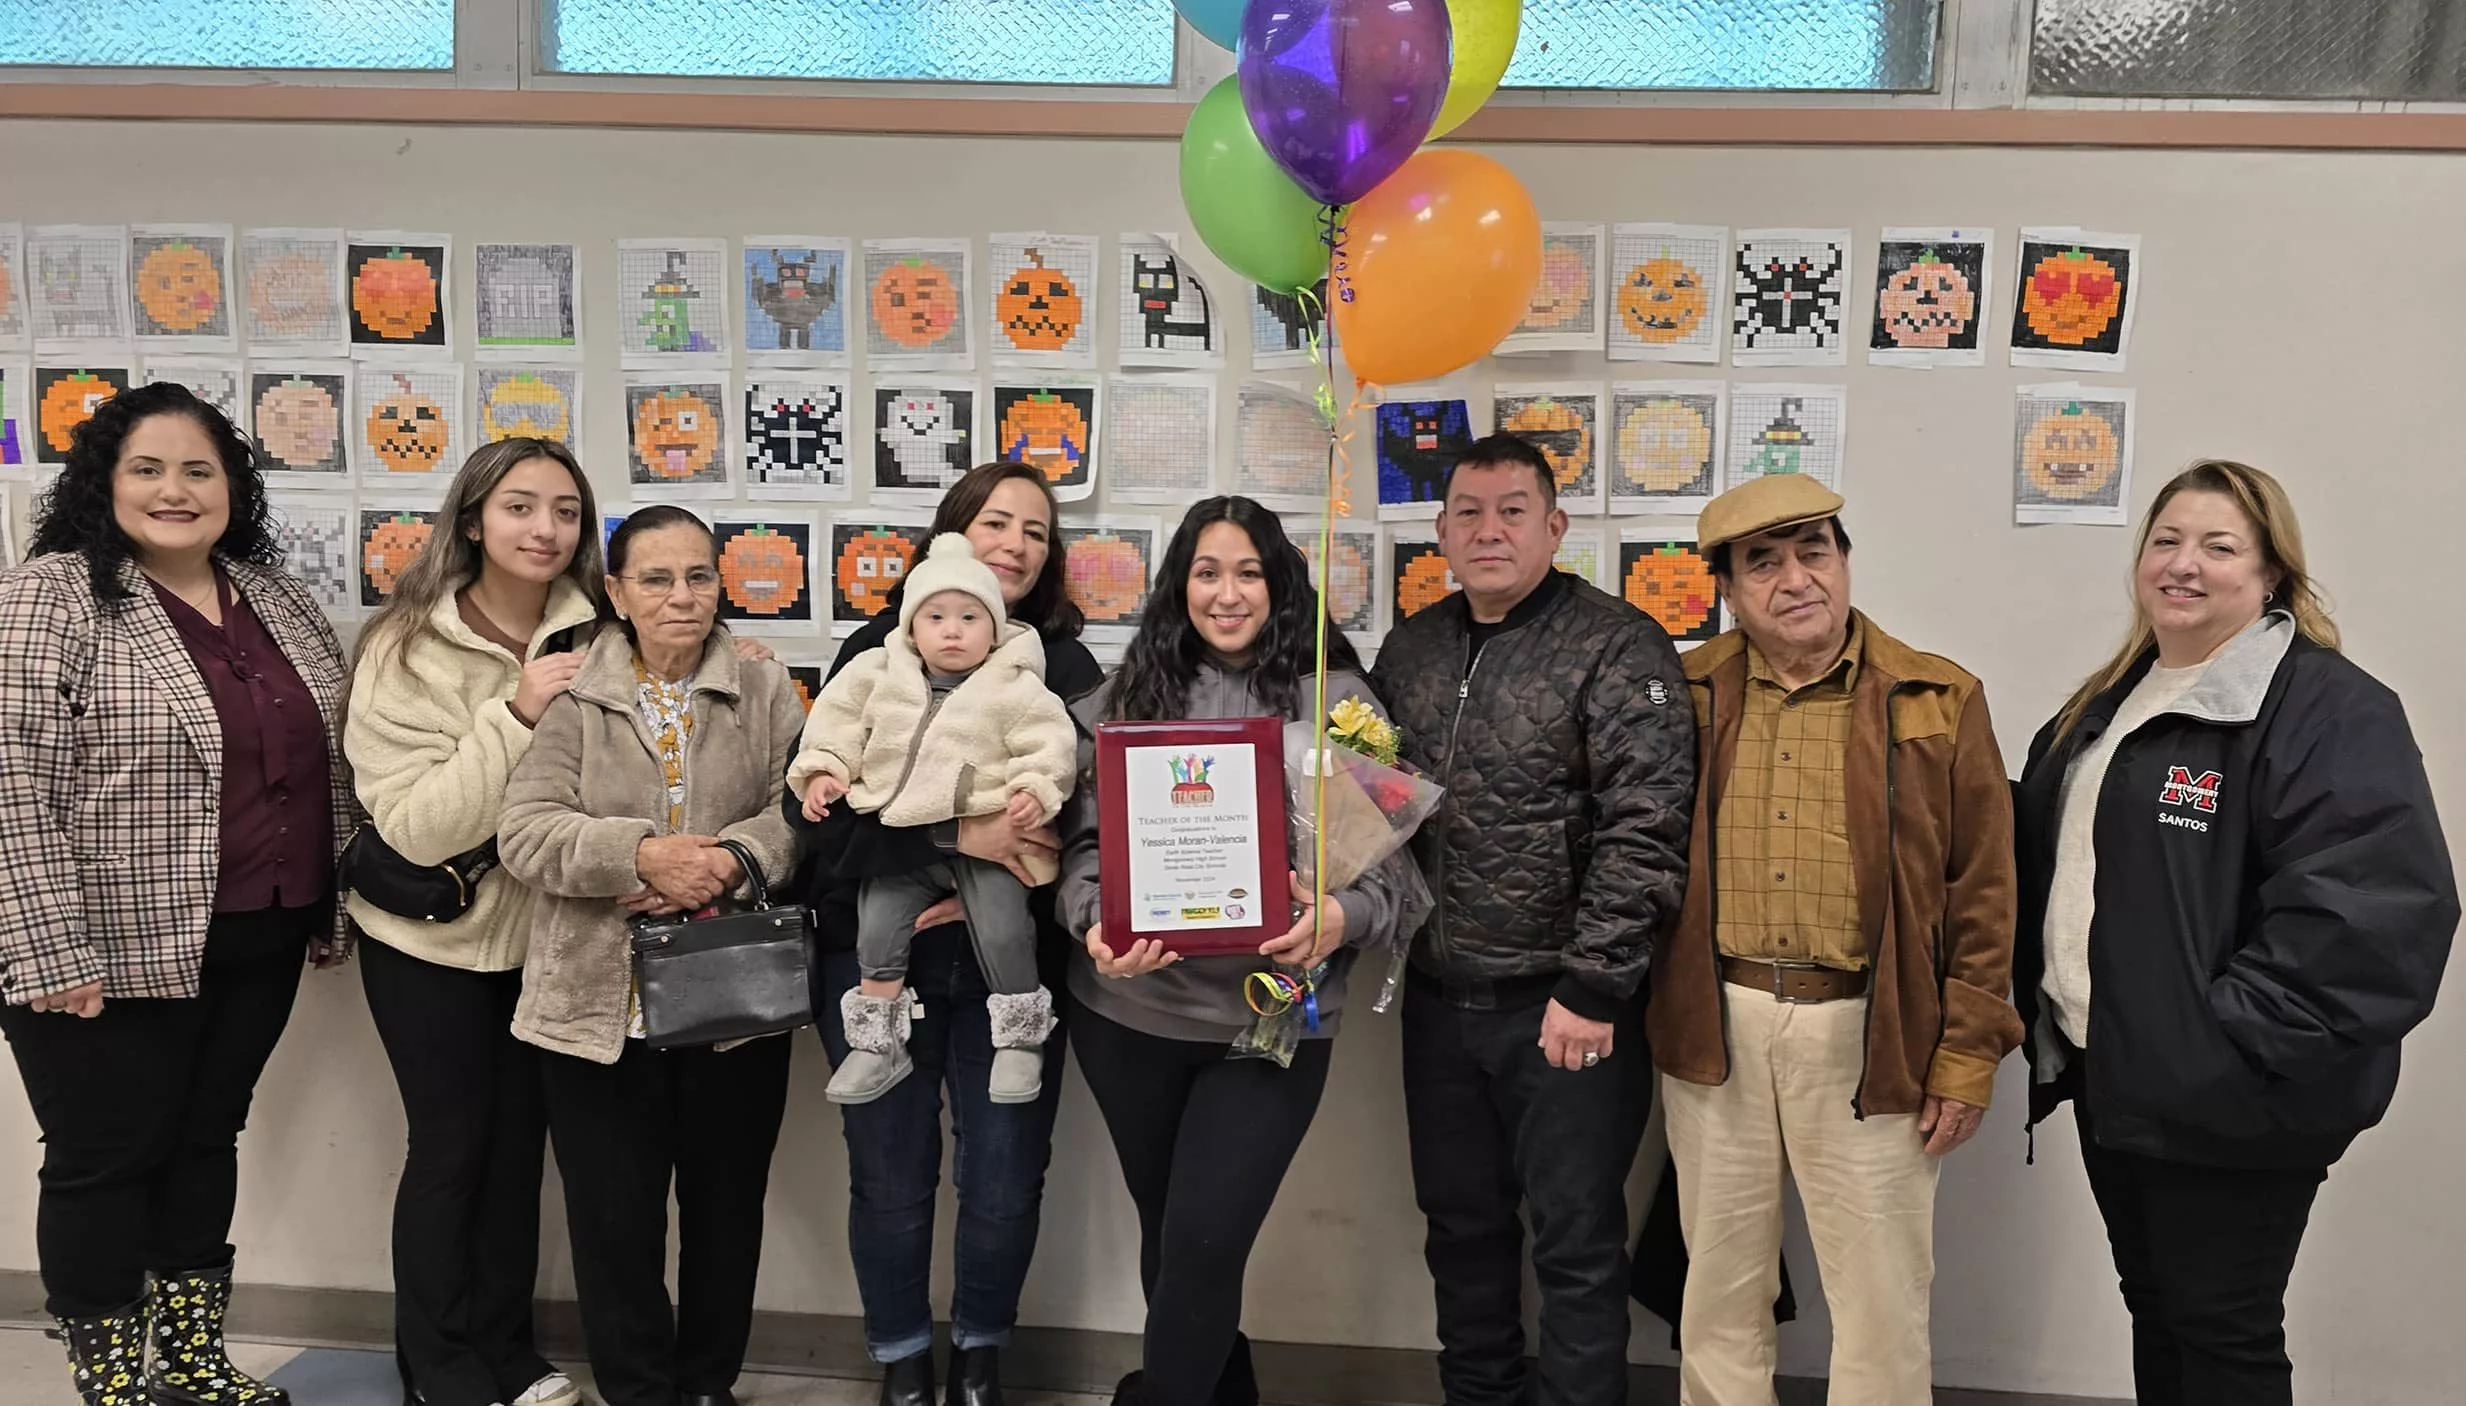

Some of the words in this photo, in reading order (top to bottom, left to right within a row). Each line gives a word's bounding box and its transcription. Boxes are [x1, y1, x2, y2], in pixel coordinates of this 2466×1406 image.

[2159, 765, 2223, 814] M
[1138, 816, 1179, 826] TEACHER
[1194, 815, 1211, 824] THE
[2158, 812, 2209, 832] SANTOS
[1141, 836, 1175, 847] Yessica
